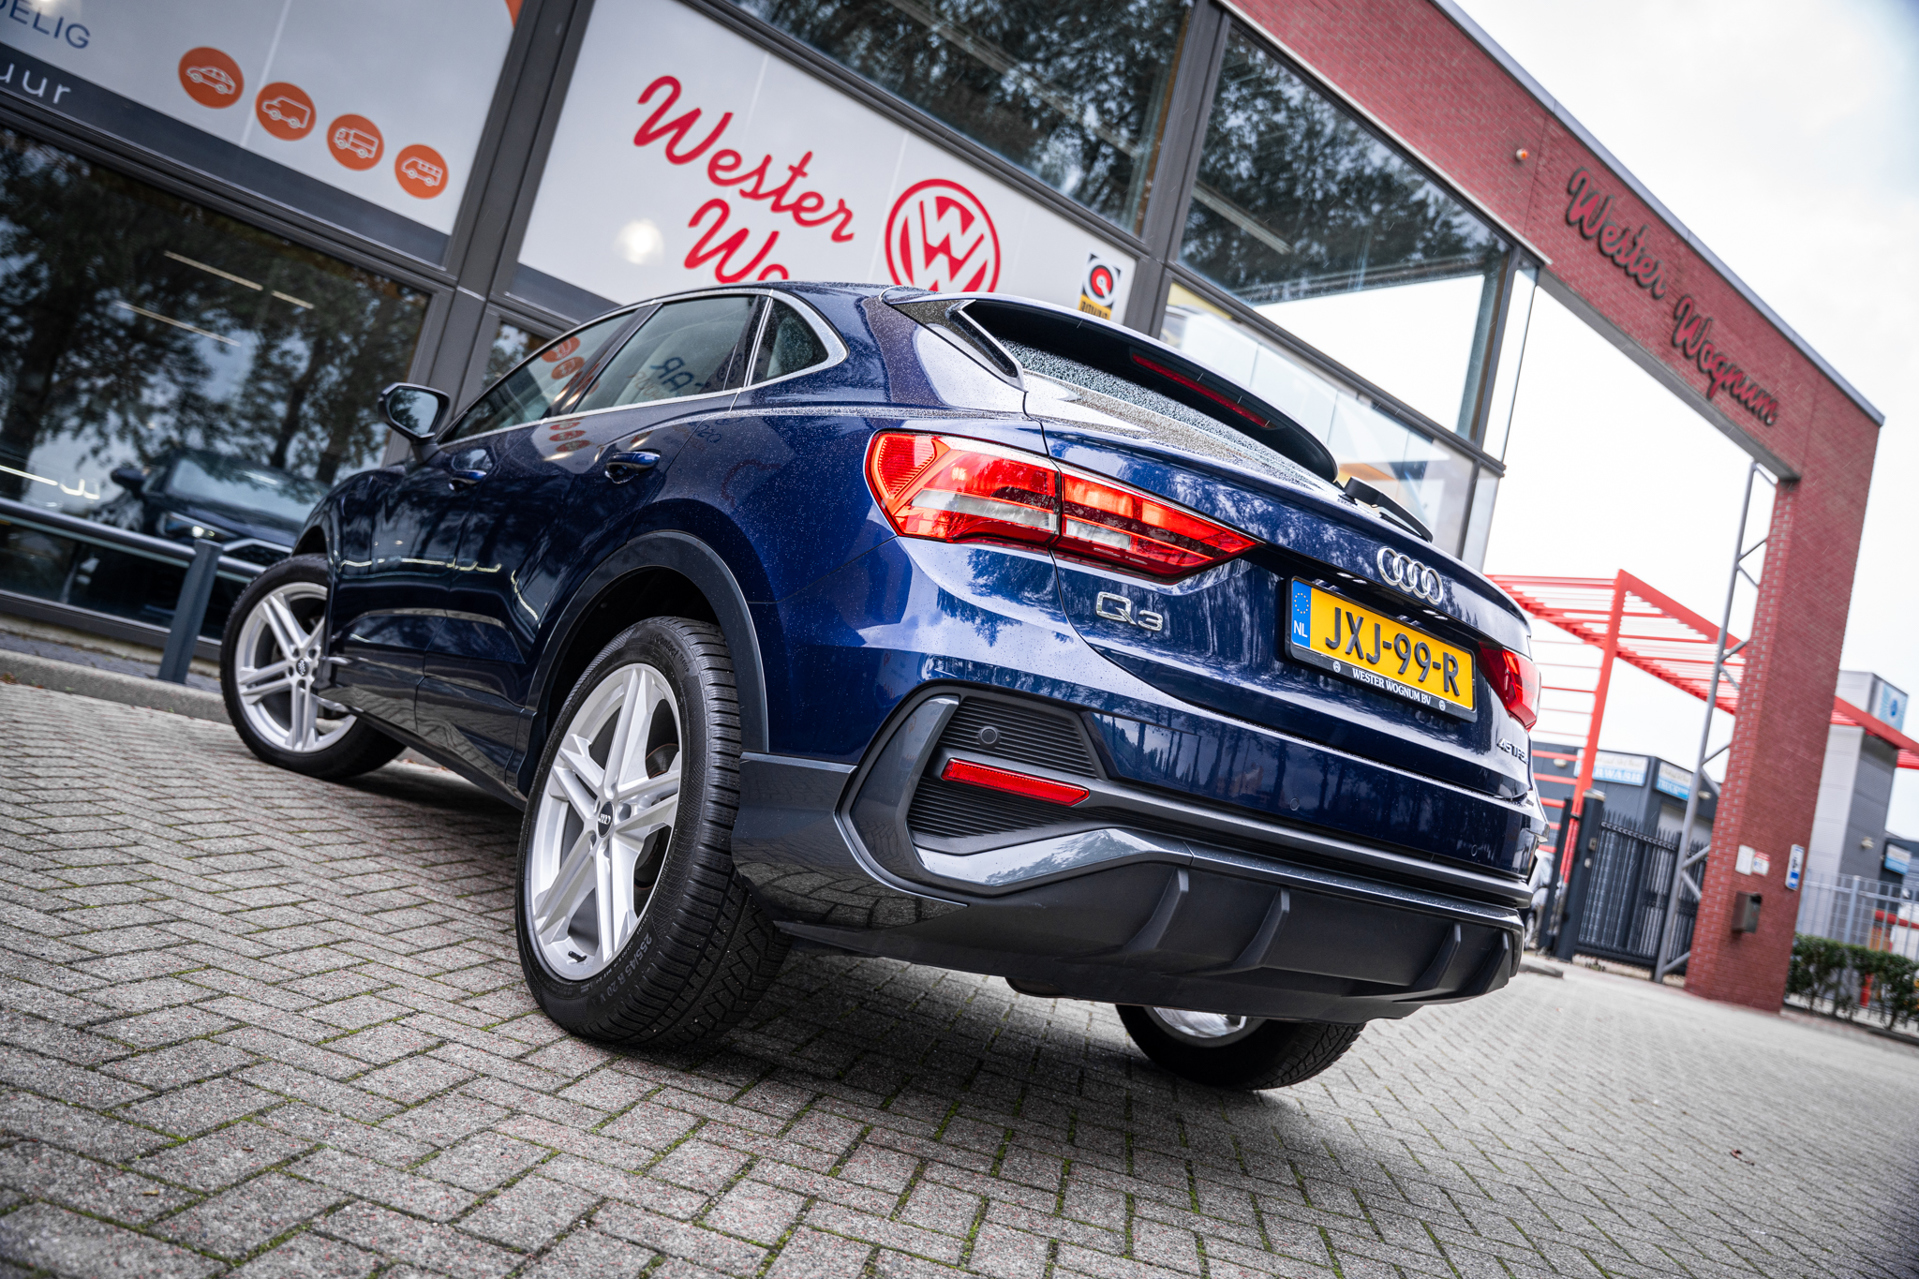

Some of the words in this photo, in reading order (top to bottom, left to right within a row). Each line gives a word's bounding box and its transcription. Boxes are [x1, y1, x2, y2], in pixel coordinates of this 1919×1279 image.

[633, 75, 855, 243] Wester
[1566, 166, 1666, 300] Wester
[1672, 293, 1779, 427] Wognum
[1096, 591, 1163, 632] Q3
[1293, 620, 1308, 638] NL
[1325, 606, 1460, 697] JXJ-99-R
[1351, 667, 1385, 688] WESTER
[1385, 678, 1421, 702] WOGNUM
[1421, 694, 1432, 706] BV
